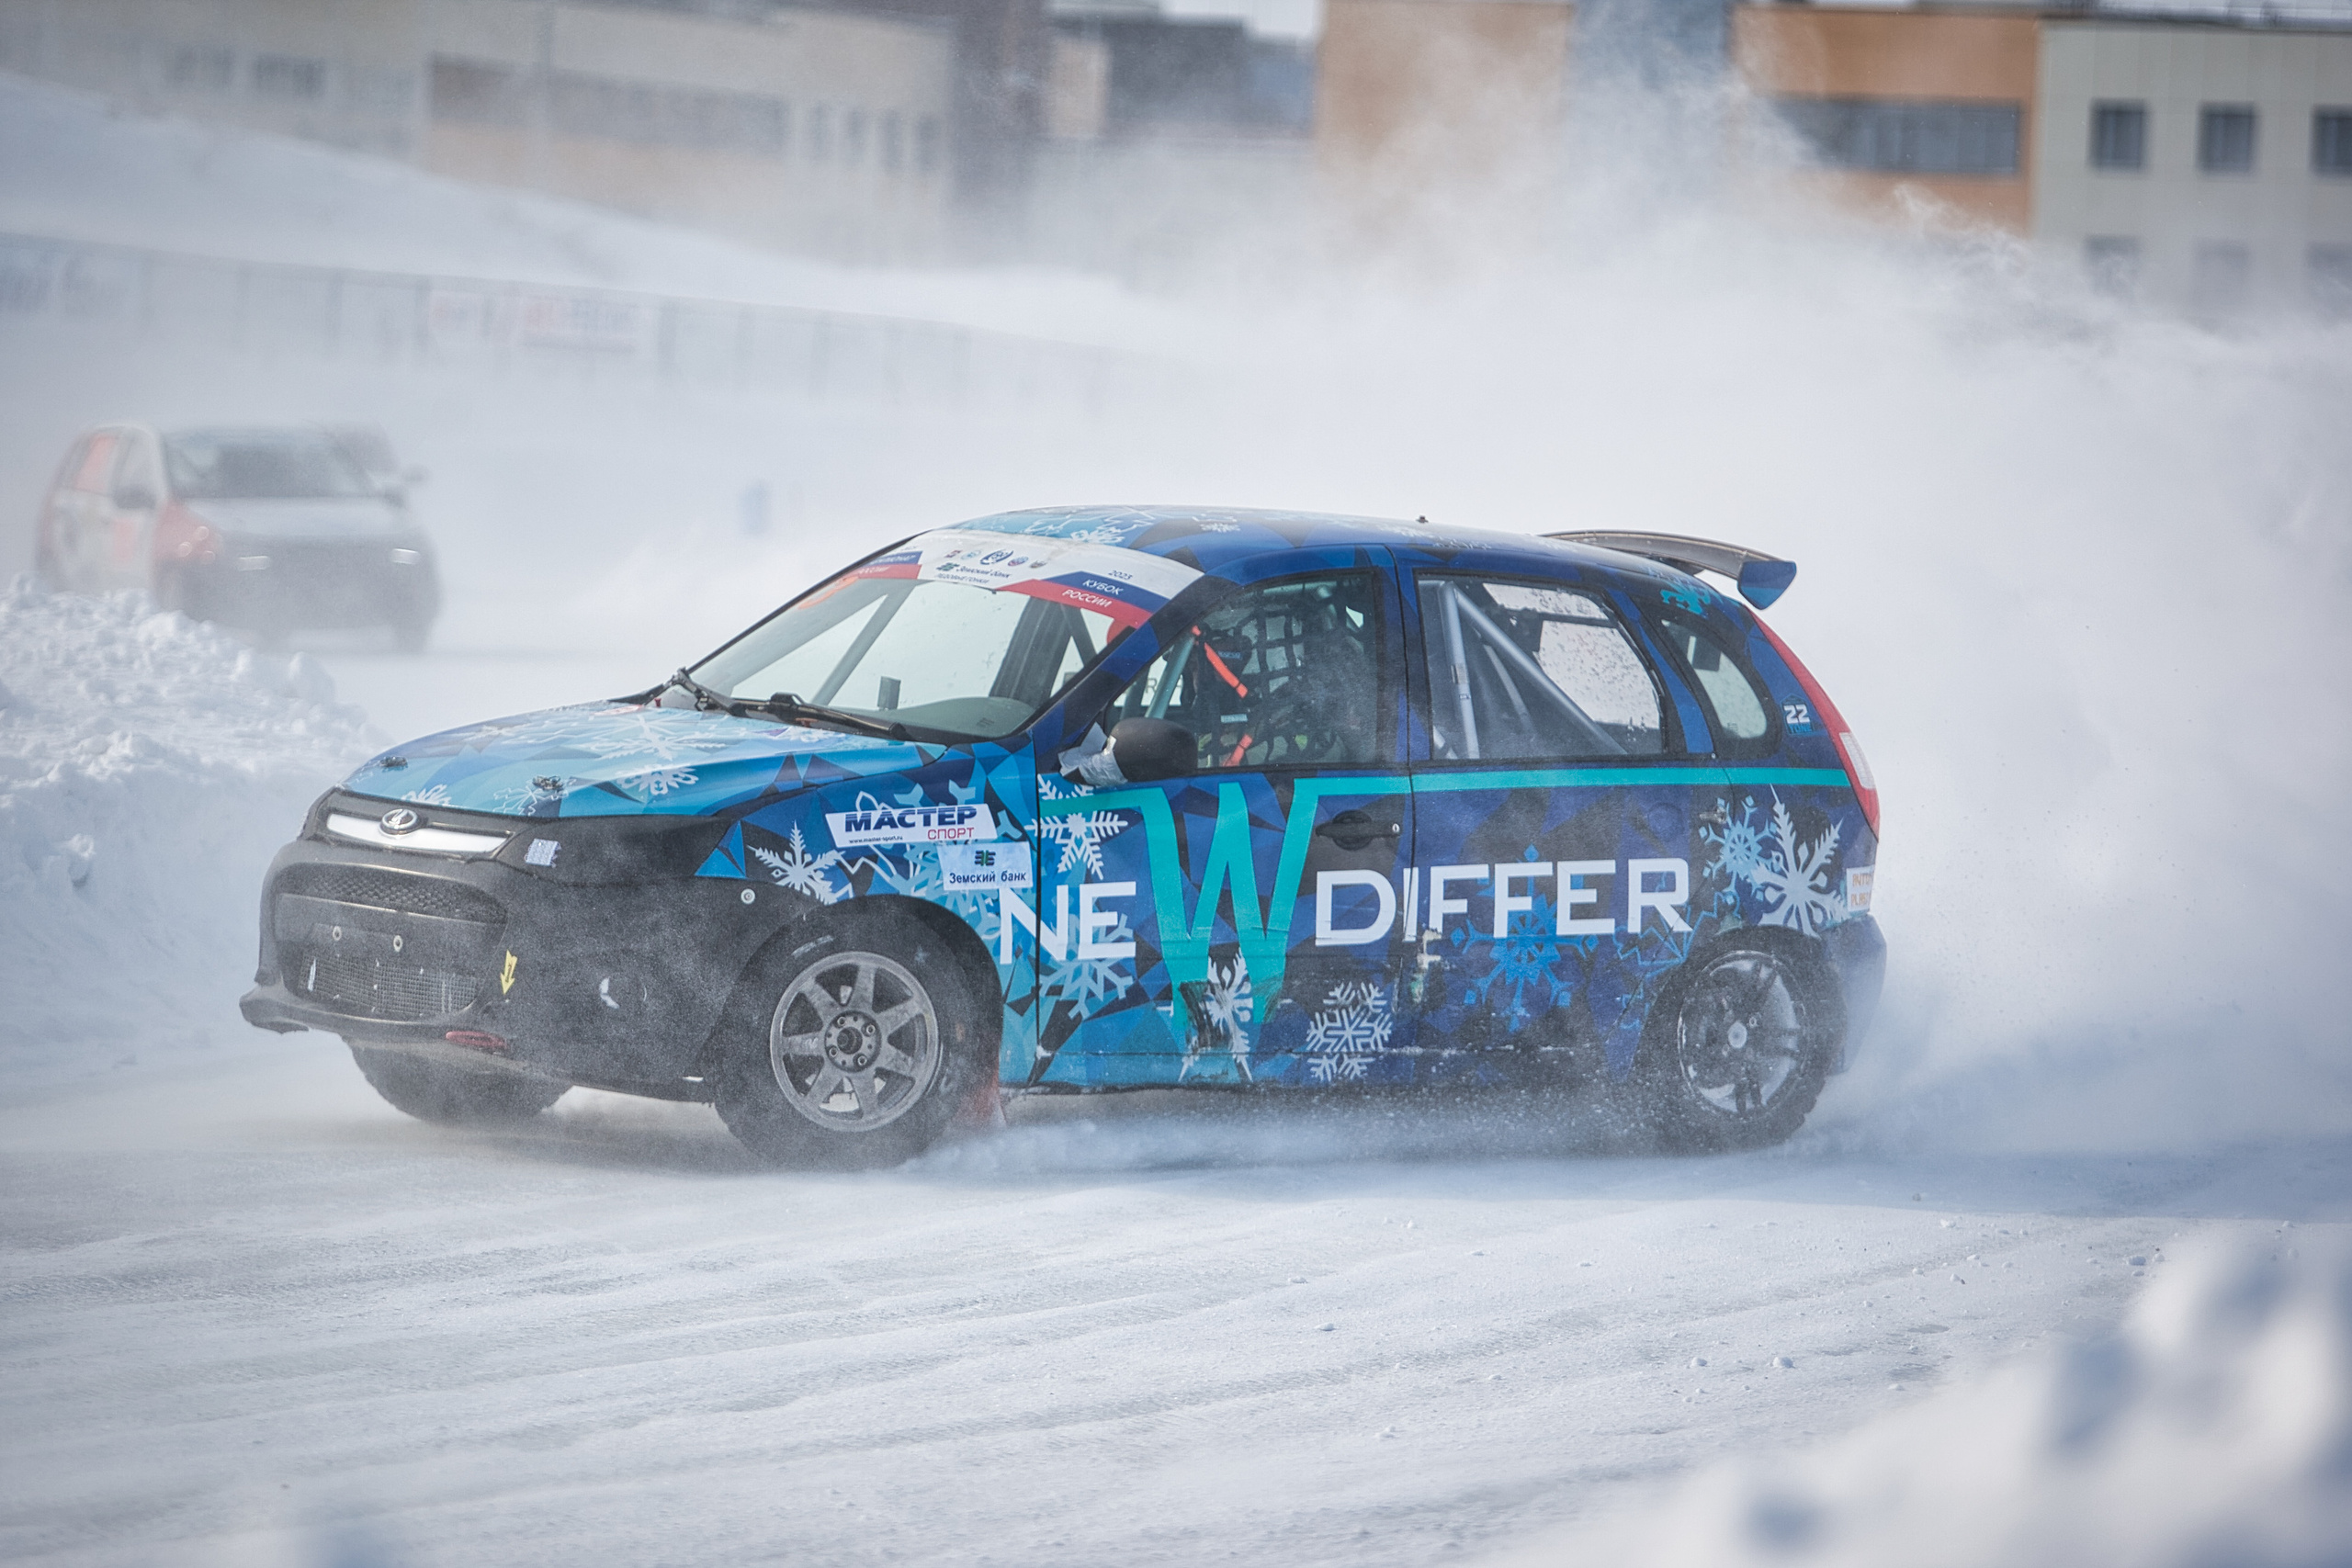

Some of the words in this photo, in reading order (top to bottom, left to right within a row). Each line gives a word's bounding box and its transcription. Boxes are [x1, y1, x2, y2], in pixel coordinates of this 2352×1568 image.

[1082, 579, 1124, 595] КУБОК
[1062, 589, 1112, 607] РОССИИ
[1783, 704, 1810, 724] 22
[845, 807, 977, 832] МАСТЕР
[928, 828, 974, 840] СПОРТ
[949, 870, 996, 884] Земский
[1001, 870, 1027, 882] банк
[1315, 858, 1693, 946] DIFFER
